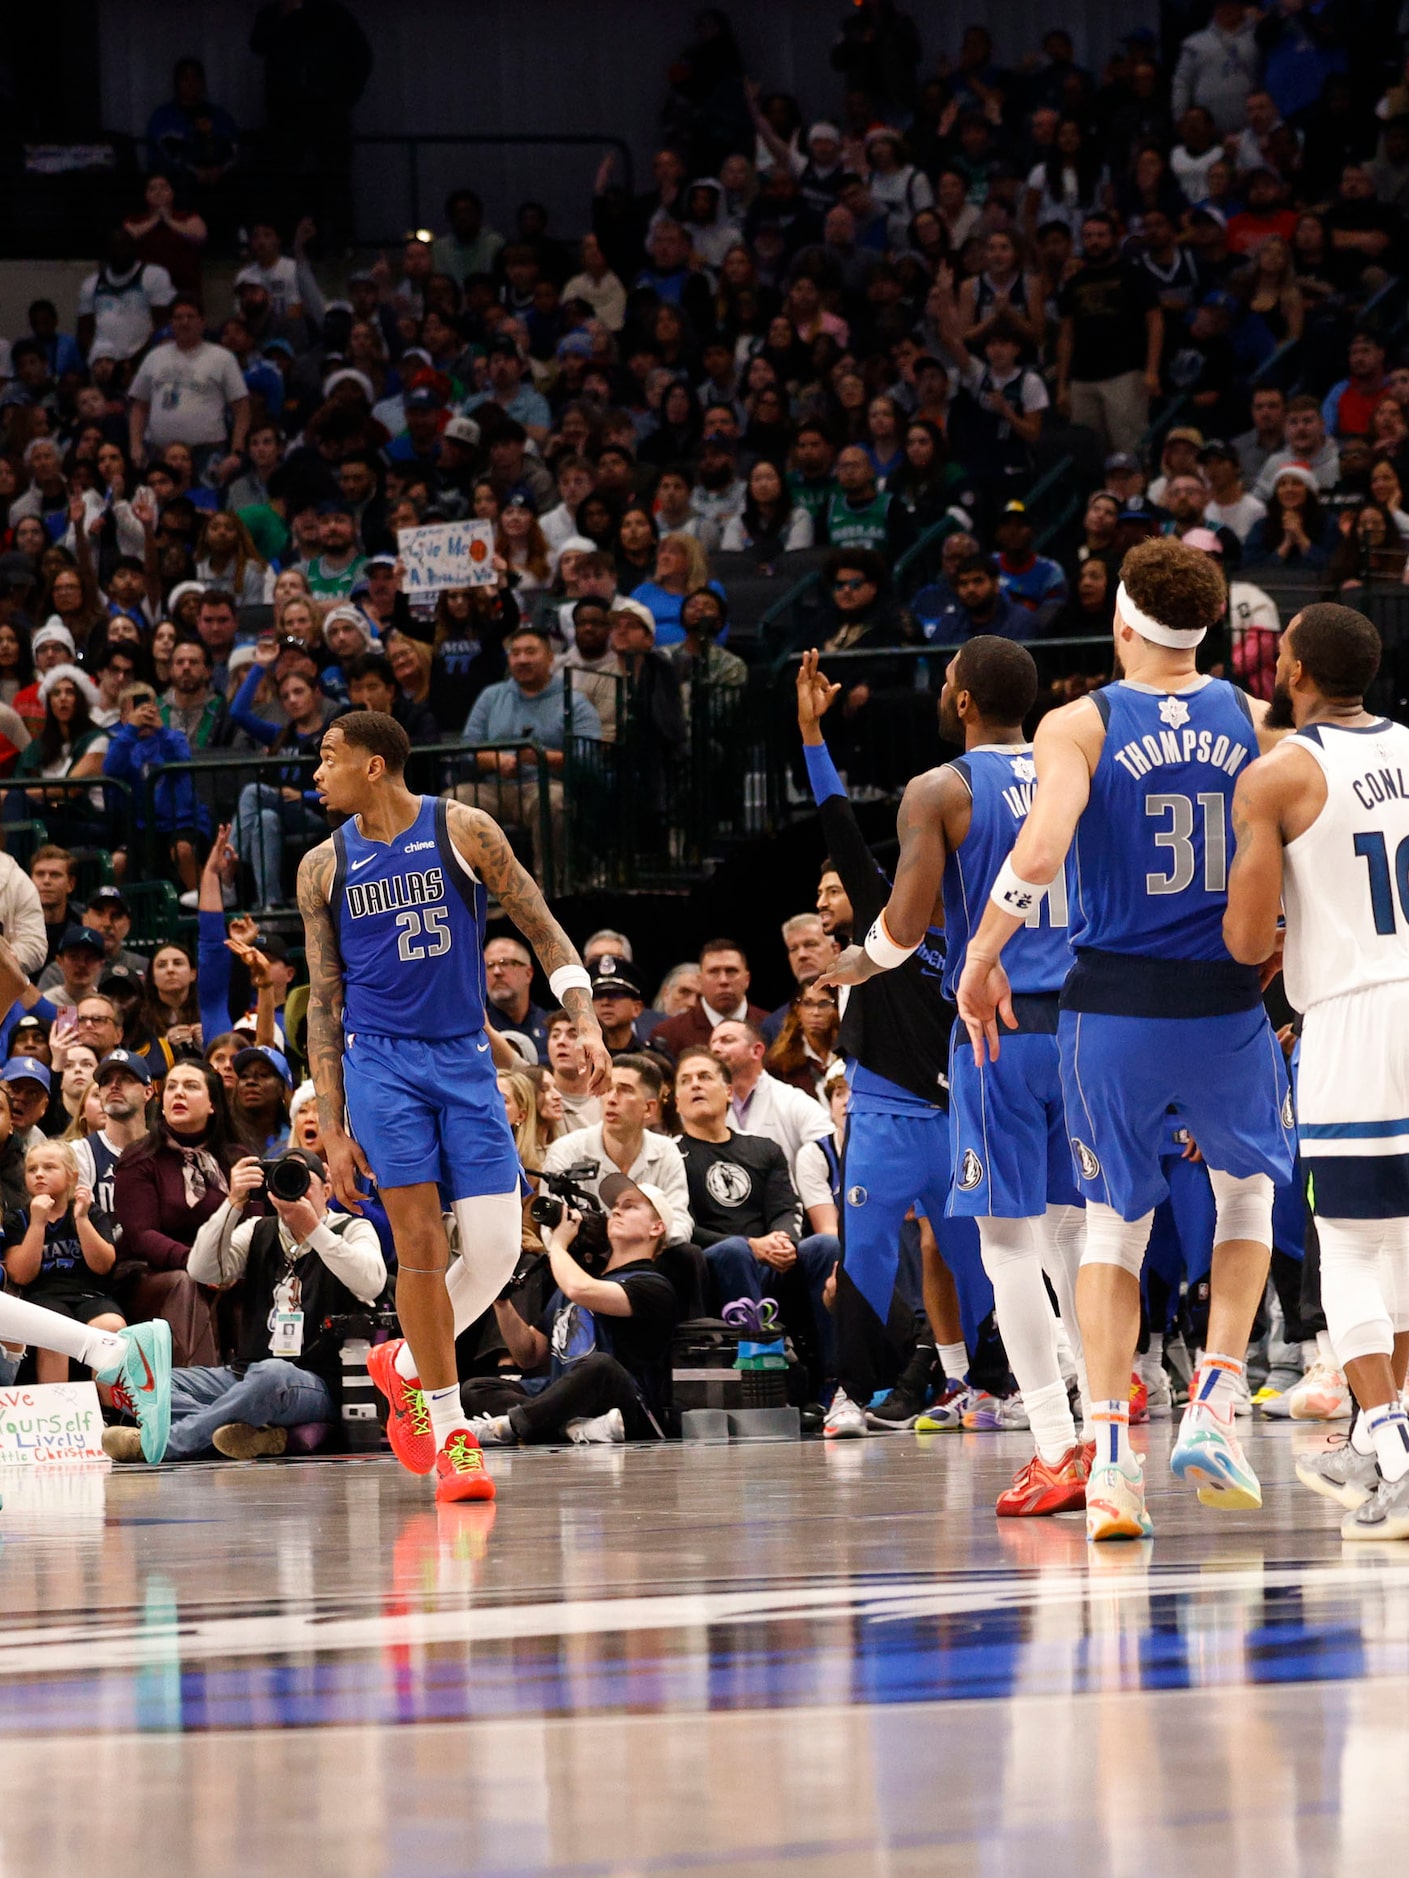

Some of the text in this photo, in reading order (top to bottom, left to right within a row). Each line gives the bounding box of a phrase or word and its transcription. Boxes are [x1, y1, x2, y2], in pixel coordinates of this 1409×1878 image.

[1114, 730, 1248, 781] THOMPSON
[404, 840, 436, 853] chime
[1145, 792, 1227, 895] 31
[346, 867, 445, 919] DALLAS
[396, 905, 452, 962] 25
[16, 1433, 86, 1449] Lively
